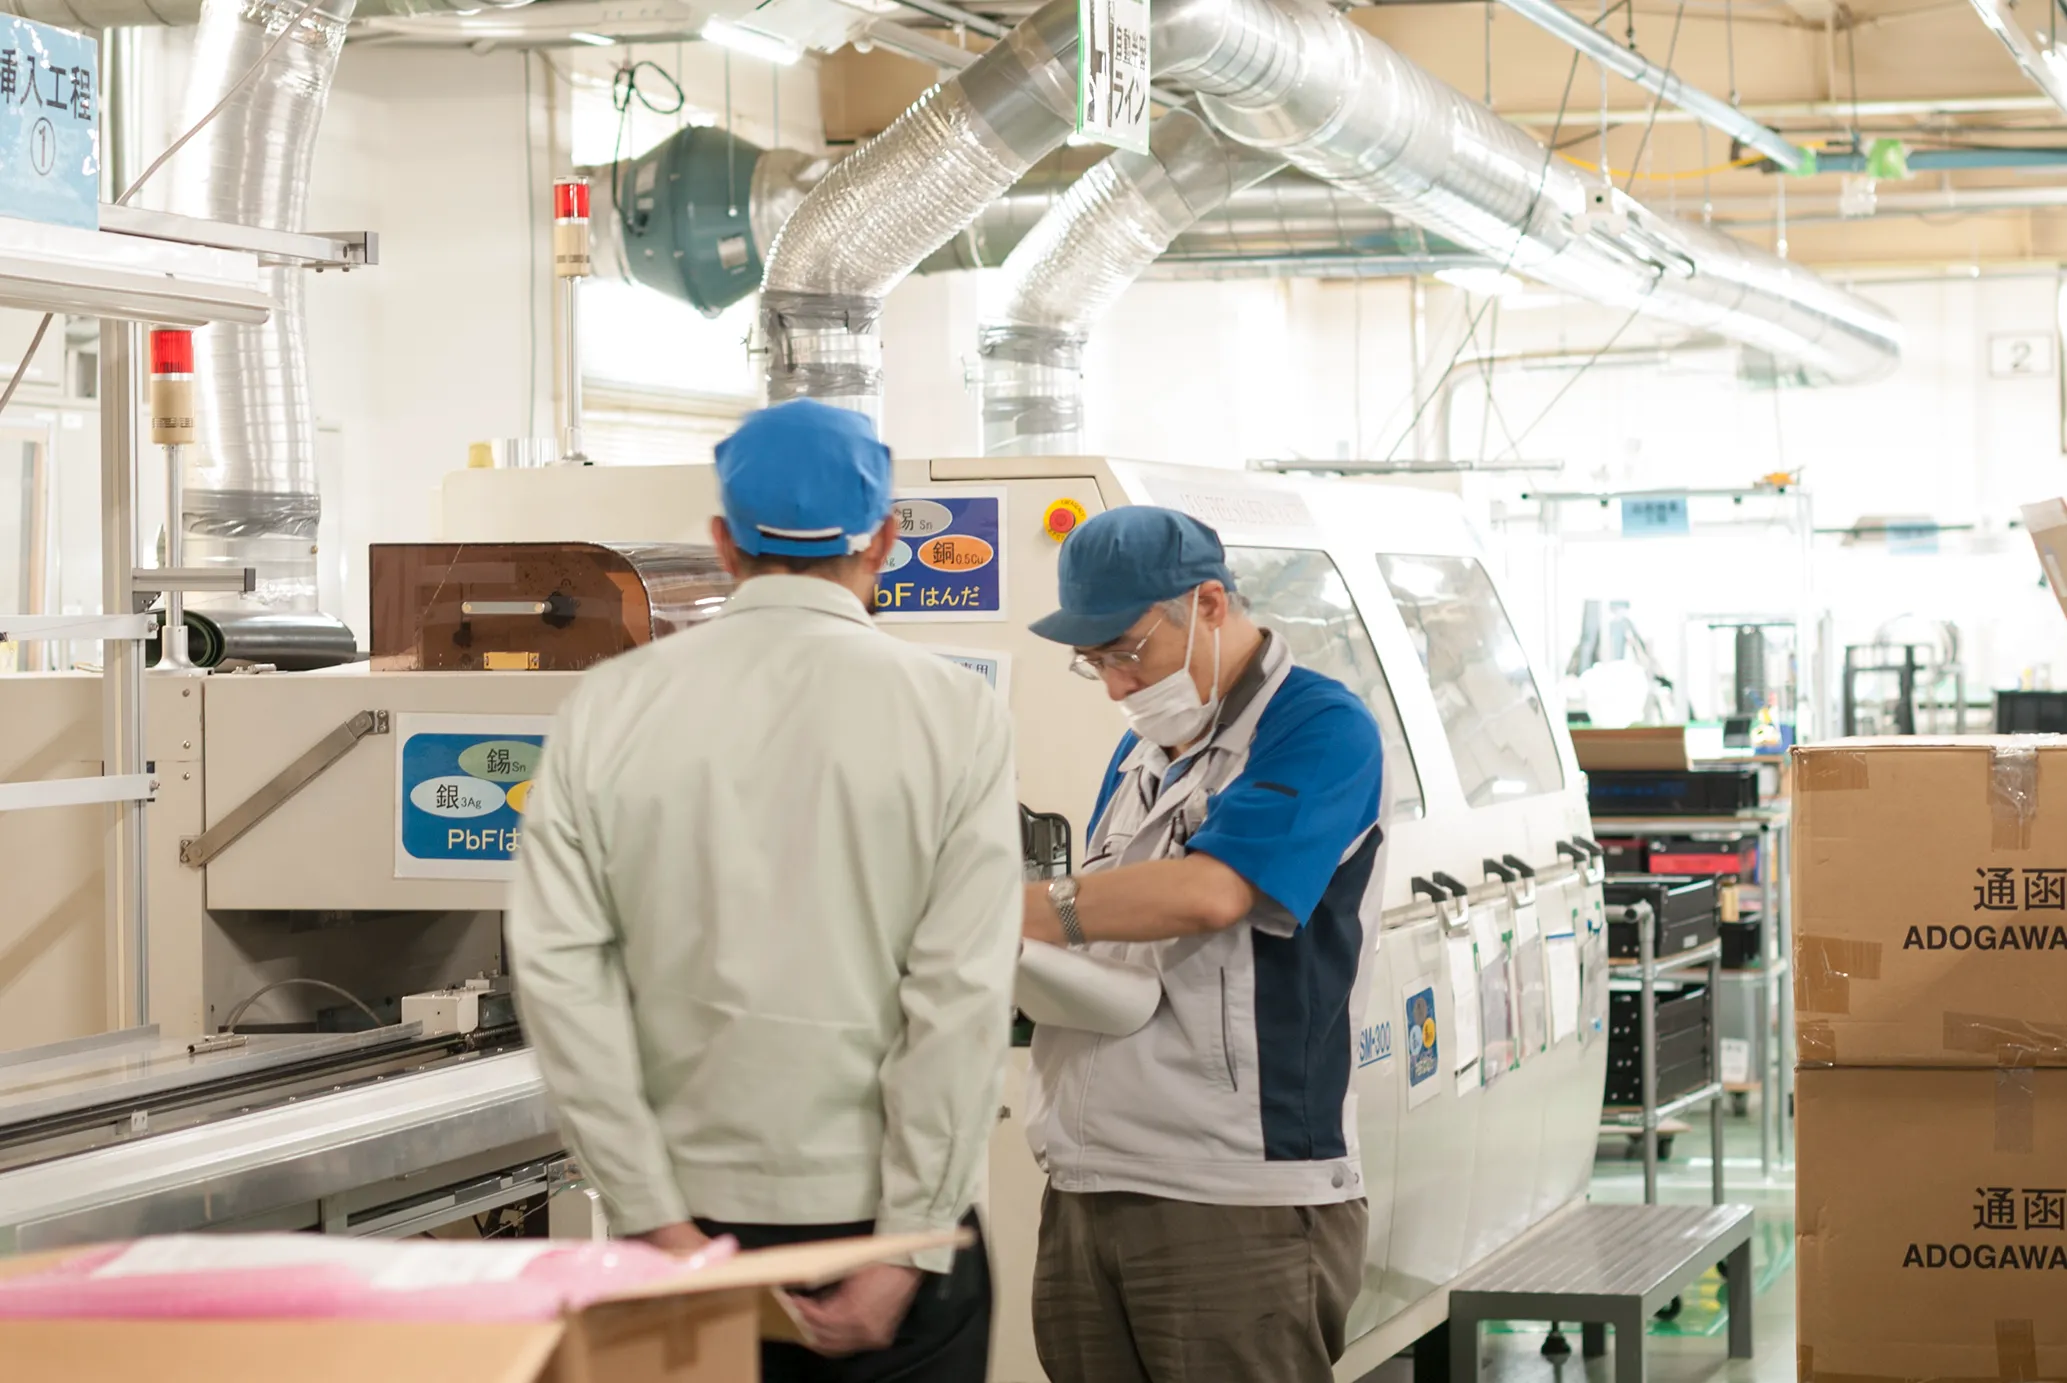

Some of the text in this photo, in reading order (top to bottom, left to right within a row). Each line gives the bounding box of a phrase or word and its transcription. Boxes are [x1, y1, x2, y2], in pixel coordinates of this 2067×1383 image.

[1114, 70, 1146, 125] ライン
[920, 586, 980, 607] はんだ
[1973, 867, 2067, 911] 通函
[1903, 925, 2067, 950] ADOGAWA
[1973, 1187, 2066, 1230] 通函
[1902, 1244, 2067, 1269] ADOGAWA
